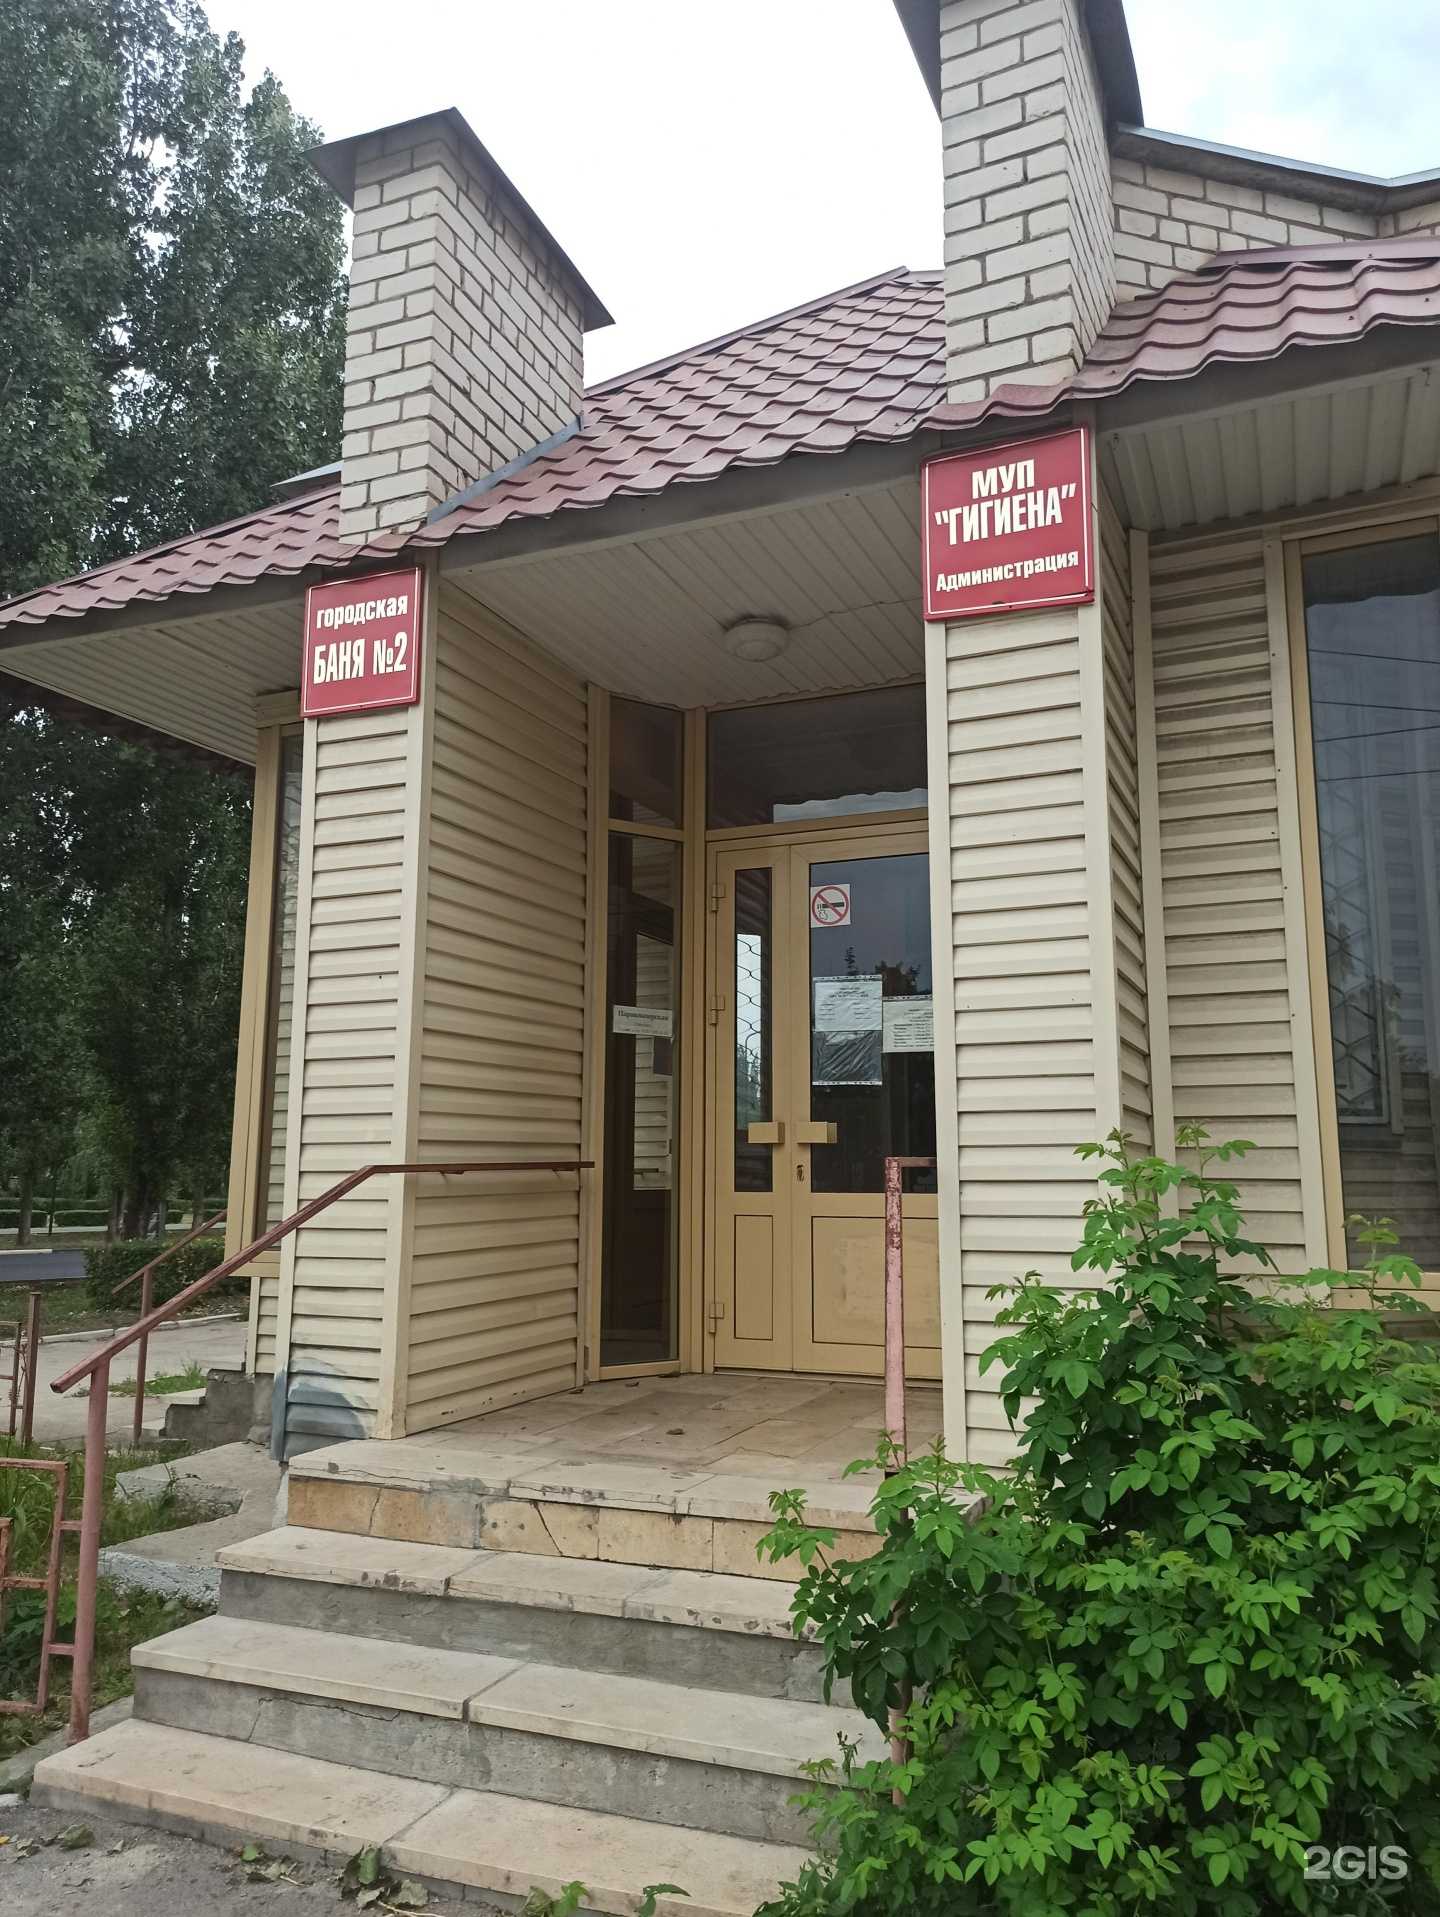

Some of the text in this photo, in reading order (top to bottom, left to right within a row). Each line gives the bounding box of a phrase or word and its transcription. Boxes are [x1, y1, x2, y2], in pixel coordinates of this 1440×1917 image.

[971, 458, 1035, 499] МУП
[934, 483, 1076, 545] "ГИГИЕНА"
[936, 551, 1079, 592] Администрация
[313, 631, 408, 685] БАНЯ №2
